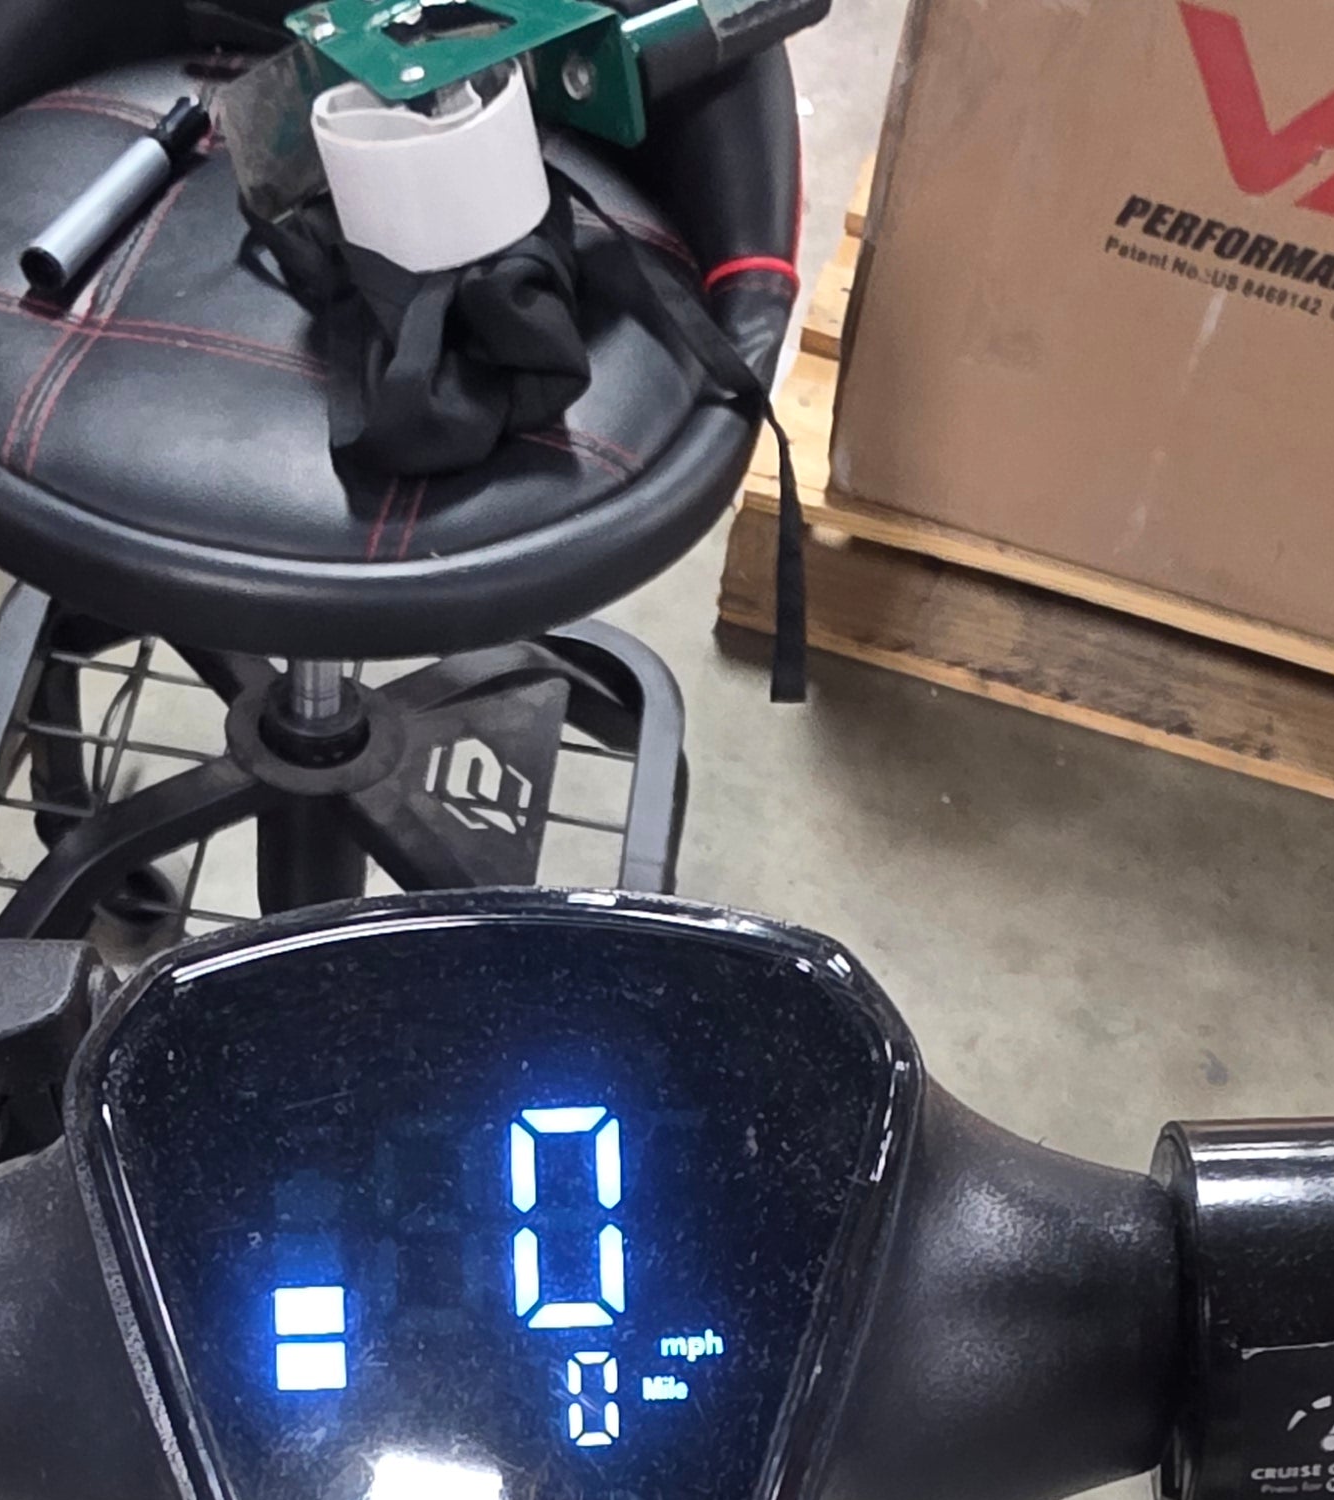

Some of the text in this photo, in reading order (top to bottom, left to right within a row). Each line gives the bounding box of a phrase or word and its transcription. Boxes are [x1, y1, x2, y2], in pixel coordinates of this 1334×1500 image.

[1104, 235, 1169, 271] Patent
[508, 1104, 626, 1329] 0
[660, 1328, 725, 1362] mph
[567, 1350, 621, 1447] 0
[1250, 1463, 1322, 1480] CRUISE
